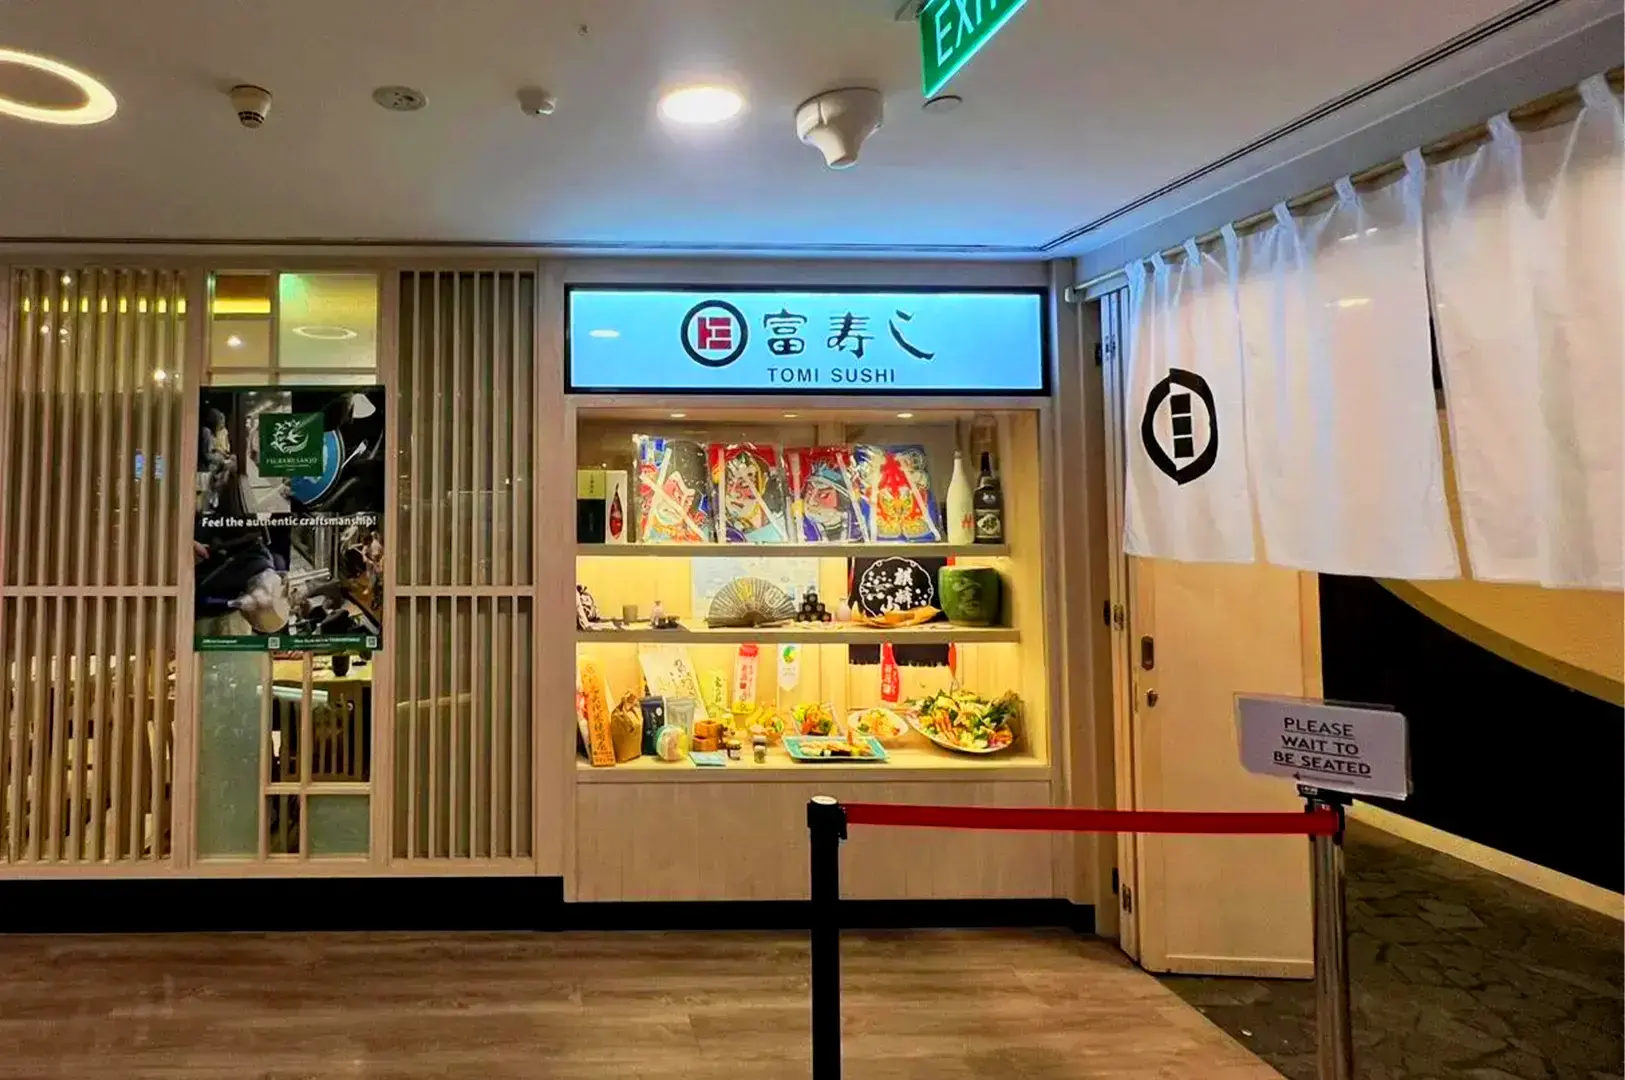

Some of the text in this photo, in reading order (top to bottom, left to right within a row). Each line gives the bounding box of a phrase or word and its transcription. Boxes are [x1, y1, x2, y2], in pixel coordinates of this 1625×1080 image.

[767, 367, 895, 383] TOMI SUSHI
[202, 515, 377, 528] Feel the authentic craftsmanship!
[1284, 717, 1354, 737] PLEASE
[1281, 735, 1359, 755] WAIT TO
[1273, 751, 1371, 775] BE SEATED
